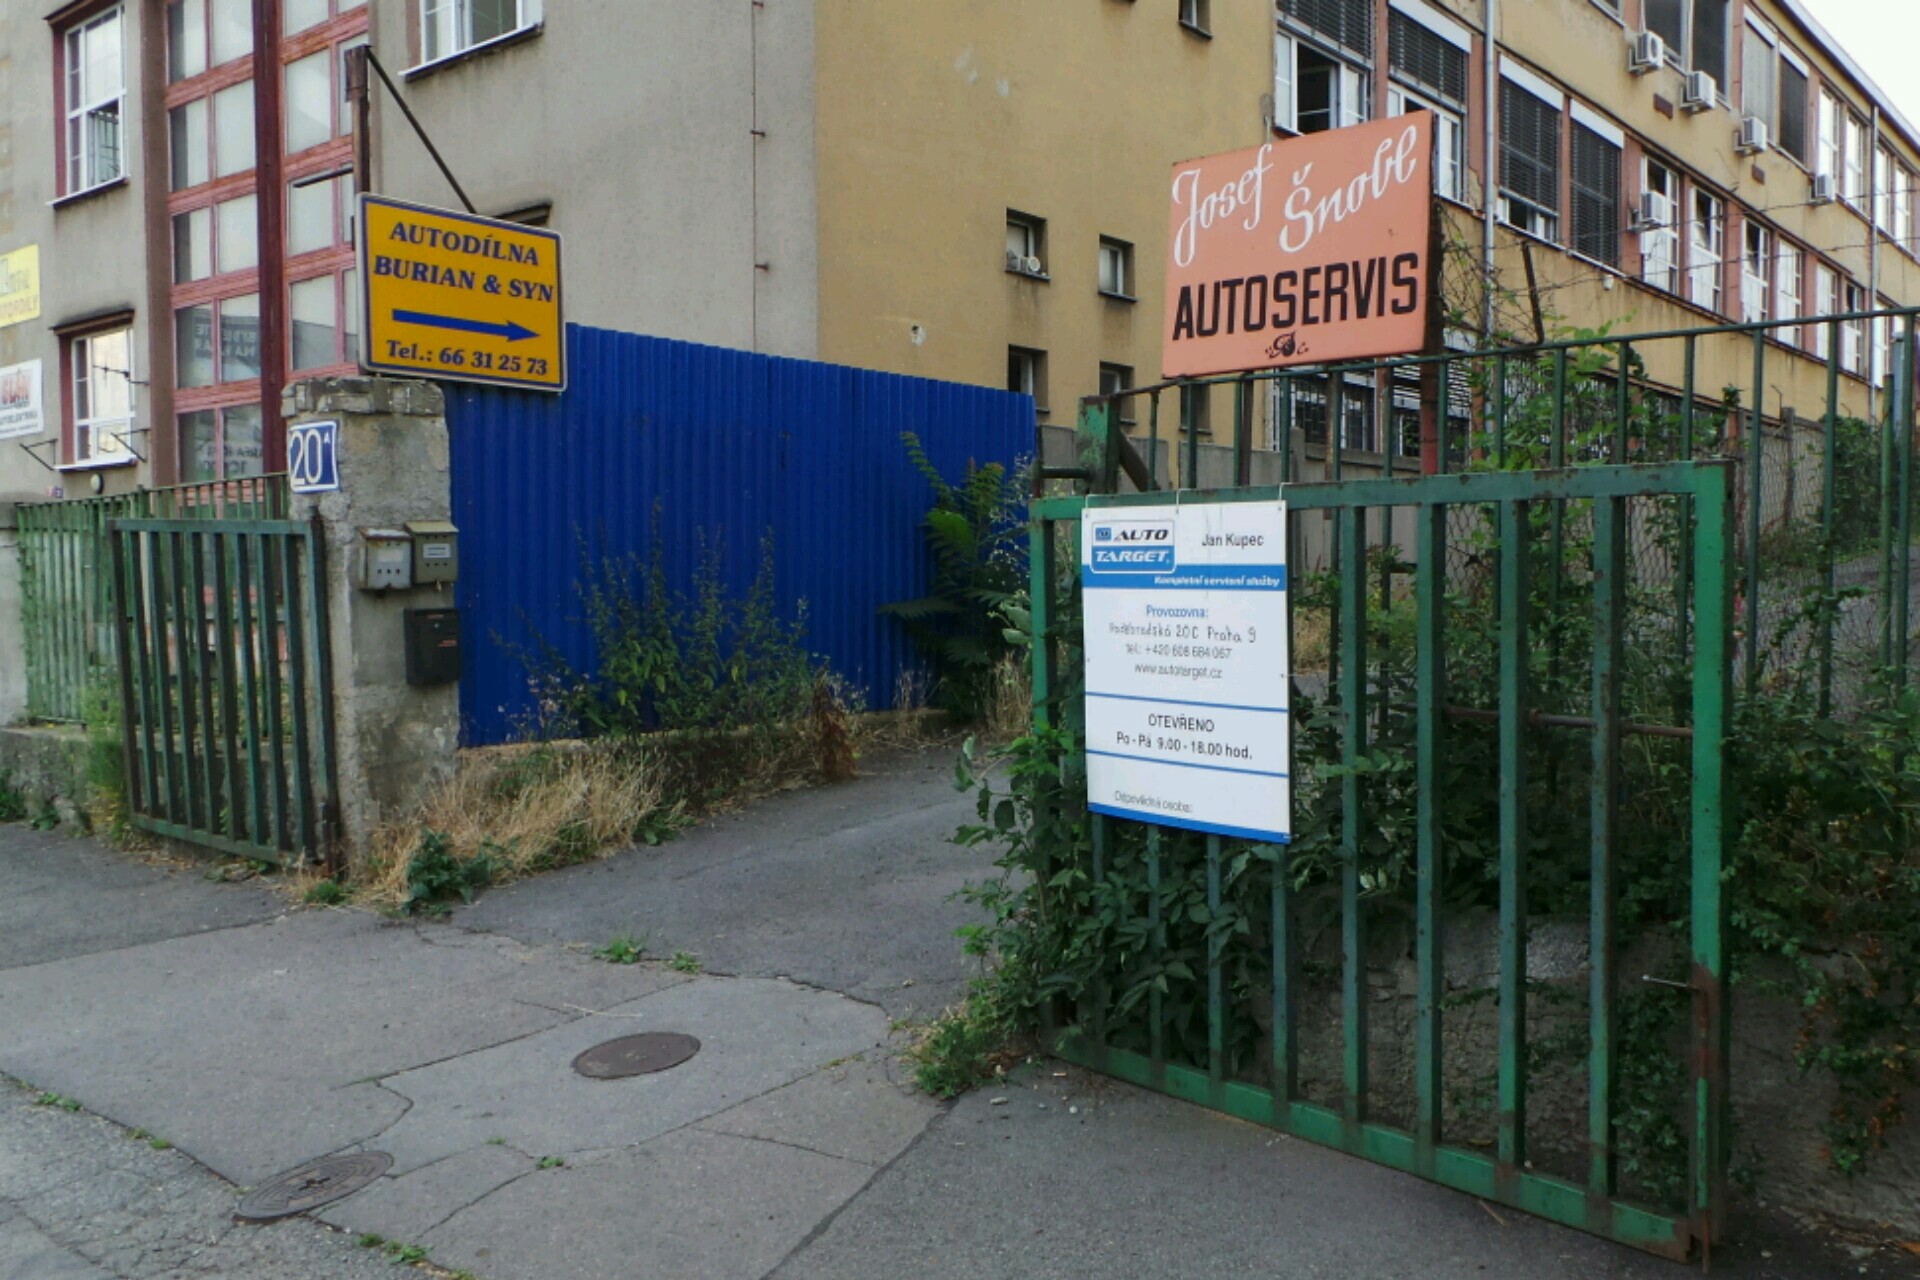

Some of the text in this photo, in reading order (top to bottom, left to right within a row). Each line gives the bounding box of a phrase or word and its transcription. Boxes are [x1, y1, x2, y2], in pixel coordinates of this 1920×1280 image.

[1172, 143, 1273, 267] Josef
[389, 222, 539, 266] AUTODÍLNA
[374, 255, 553, 303] BURIAN & SYN
[1172, 252, 1418, 341] AUTOSERVIS
[387, 339, 547, 375] Tel.: 66 31 25 73
[1113, 529, 1168, 541] AUTO
[1202, 533, 1264, 549] Jan Kupec
[1095, 550, 1169, 563] TARGET
[1146, 605, 1209, 618] Provozovna:
[1249, 626, 1256, 643] 9
[1149, 713, 1214, 732] OTEVŘENO
[1117, 731, 1129, 745] Po
[1157, 737, 1181, 751] 9.00
[1226, 744, 1252, 759] hod.
